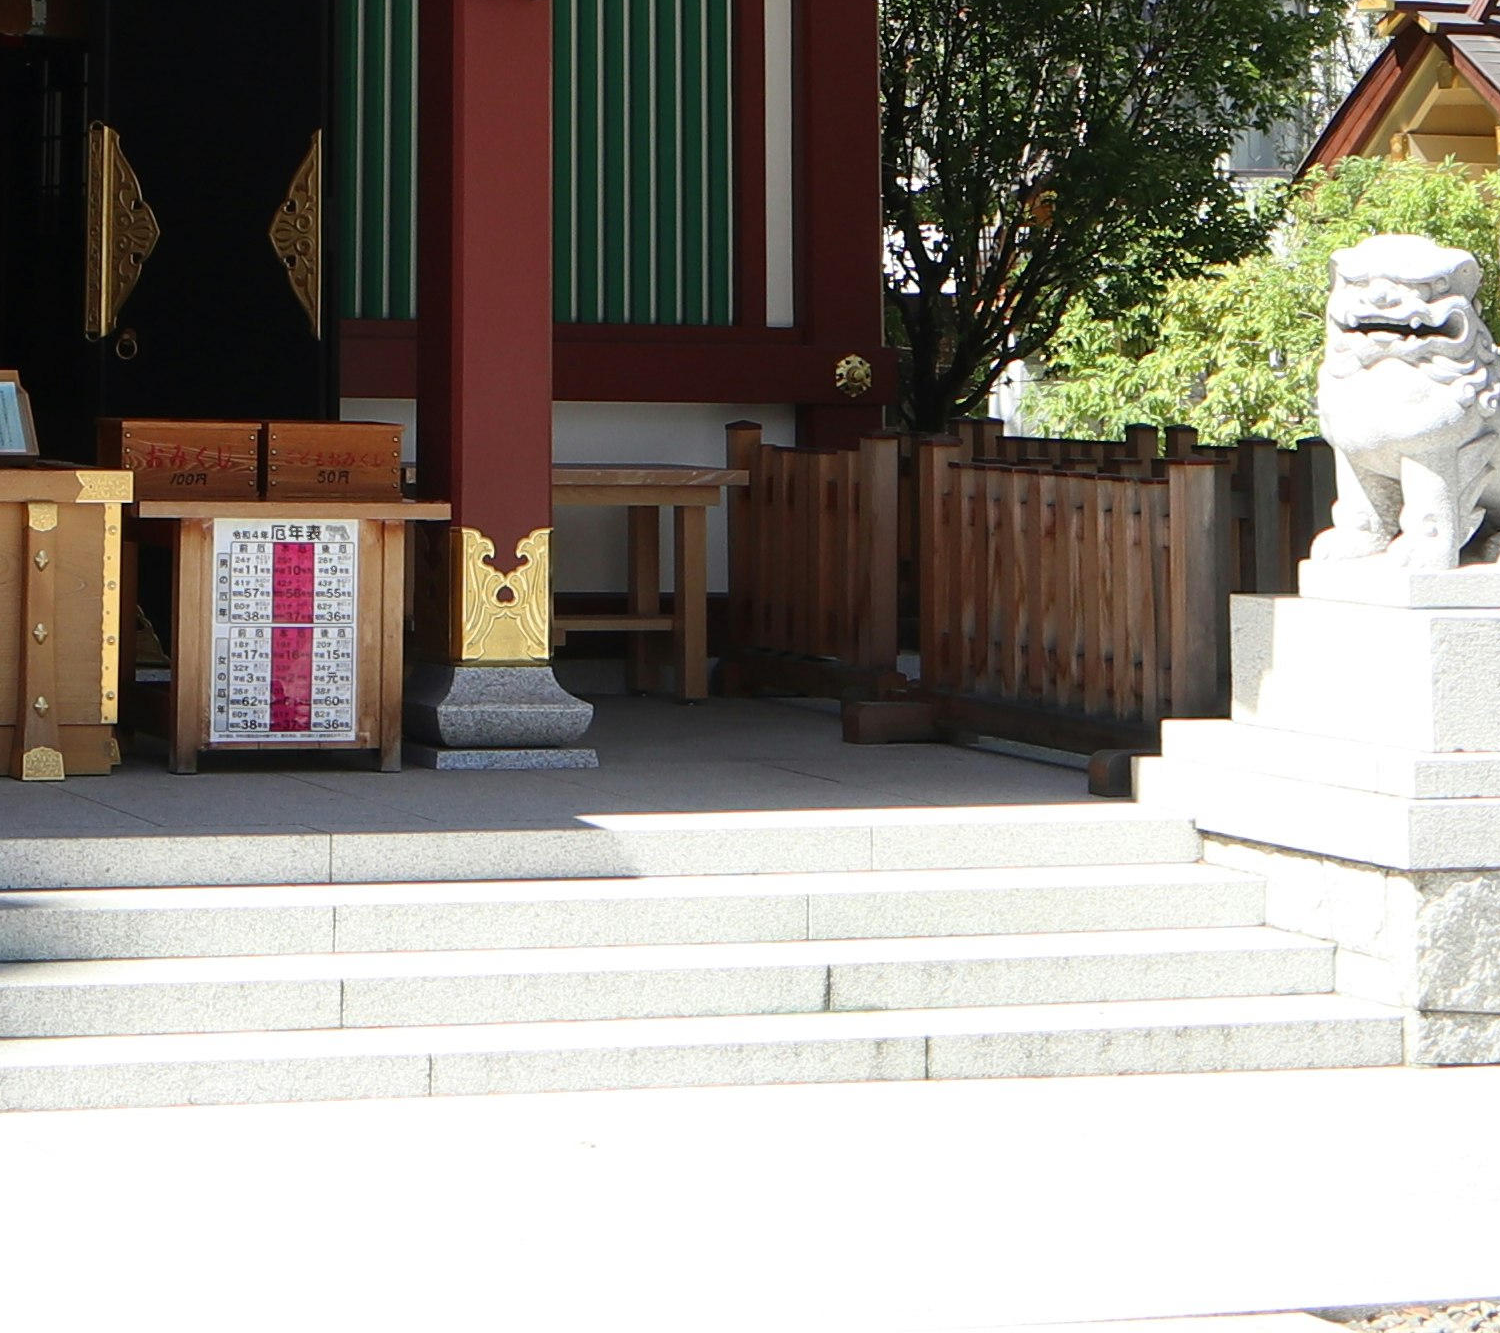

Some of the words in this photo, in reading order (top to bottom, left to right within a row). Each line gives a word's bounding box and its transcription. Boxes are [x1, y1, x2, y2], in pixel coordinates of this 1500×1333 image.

[146, 444, 234, 470] おみくじ
[170, 473, 207, 486] 100円
[317, 470, 350, 484] 50円
[233, 530, 269, 539] 令和4年
[271, 525, 321, 540] 厄年表
